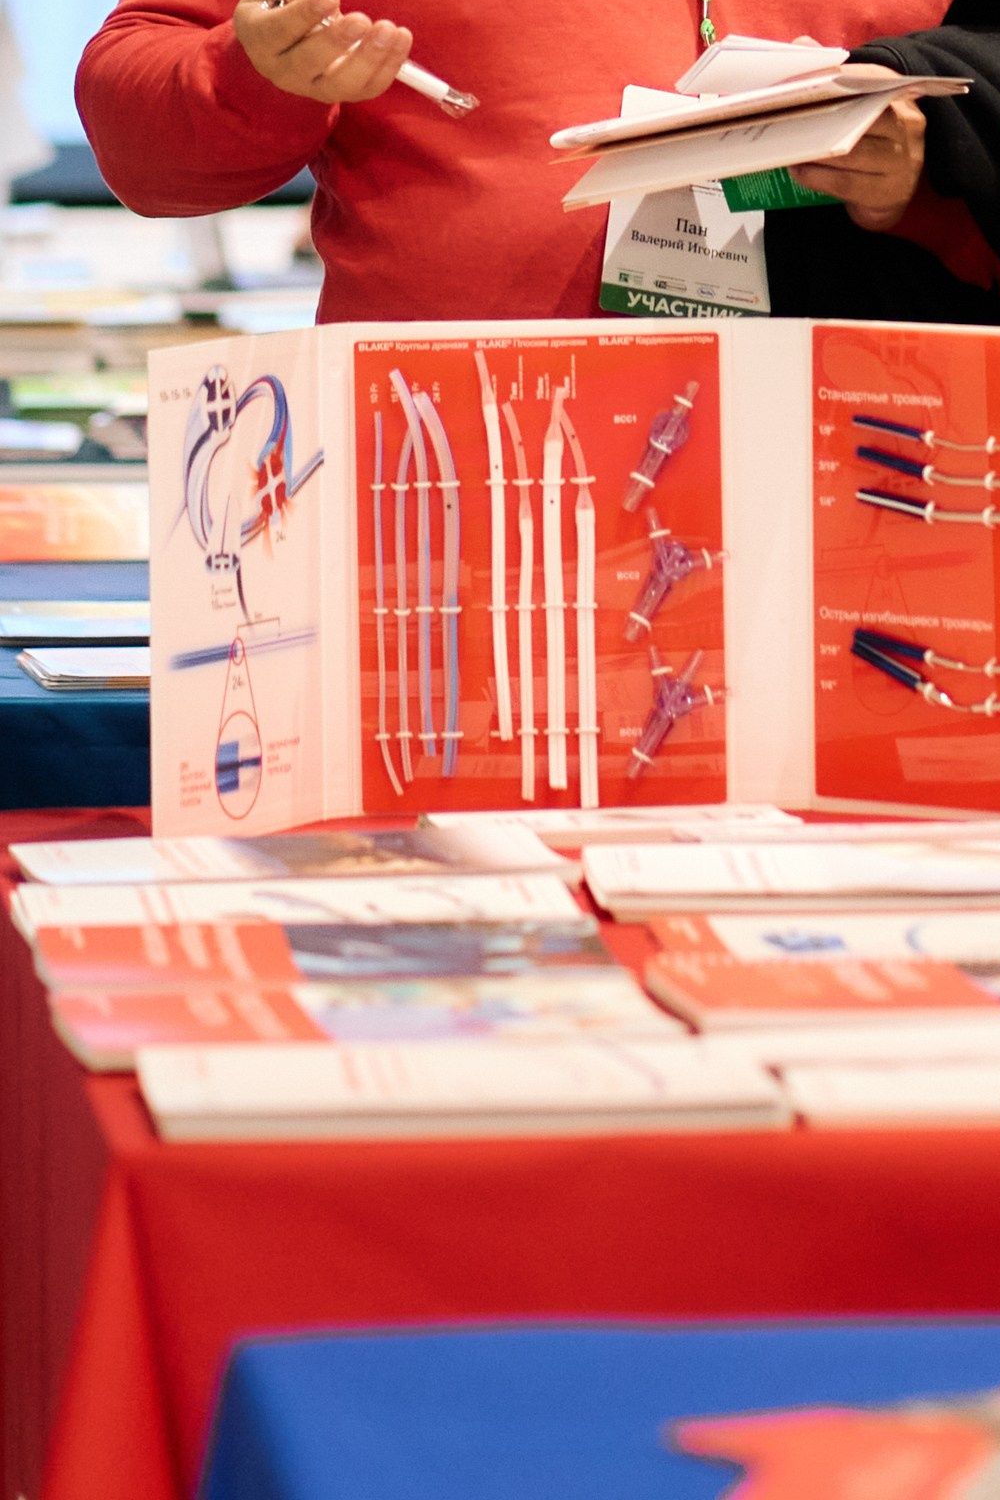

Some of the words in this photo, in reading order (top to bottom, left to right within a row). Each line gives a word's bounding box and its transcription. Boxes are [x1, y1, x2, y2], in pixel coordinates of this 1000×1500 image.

[676, 217, 708, 237] Пан
[631, 230, 684, 250] Валерий
[688, 241, 748, 263] Игоревич
[818, 386, 889, 404] Стандартные
[819, 606, 860, 622] Острые
